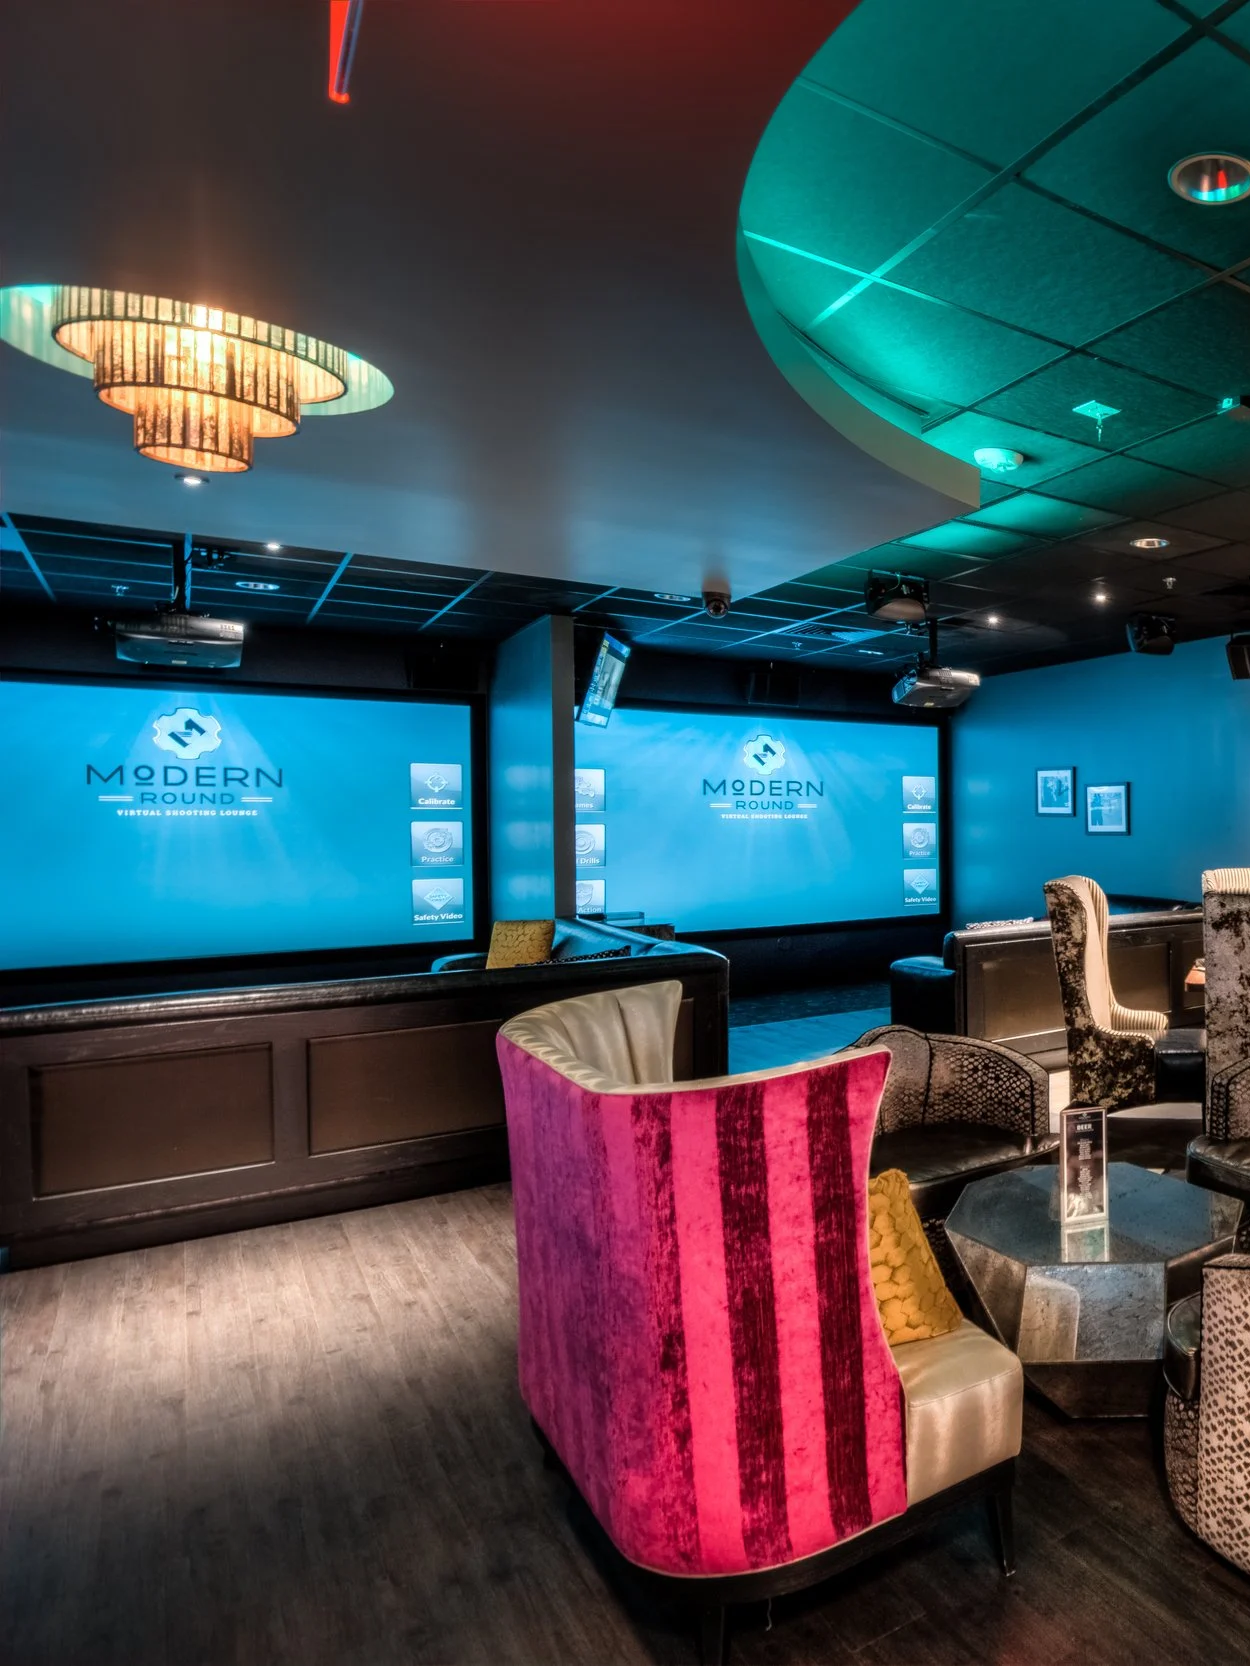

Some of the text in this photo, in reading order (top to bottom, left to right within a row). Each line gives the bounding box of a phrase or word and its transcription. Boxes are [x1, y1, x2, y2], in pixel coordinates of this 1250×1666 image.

[86, 764, 283, 788] MODERN
[702, 779, 824, 797] MODERN
[140, 792, 235, 805] ROUND
[735, 800, 794, 810] ROUND
[165, 809, 217, 817] SHOOTING
[414, 913, 439, 921] Safety
